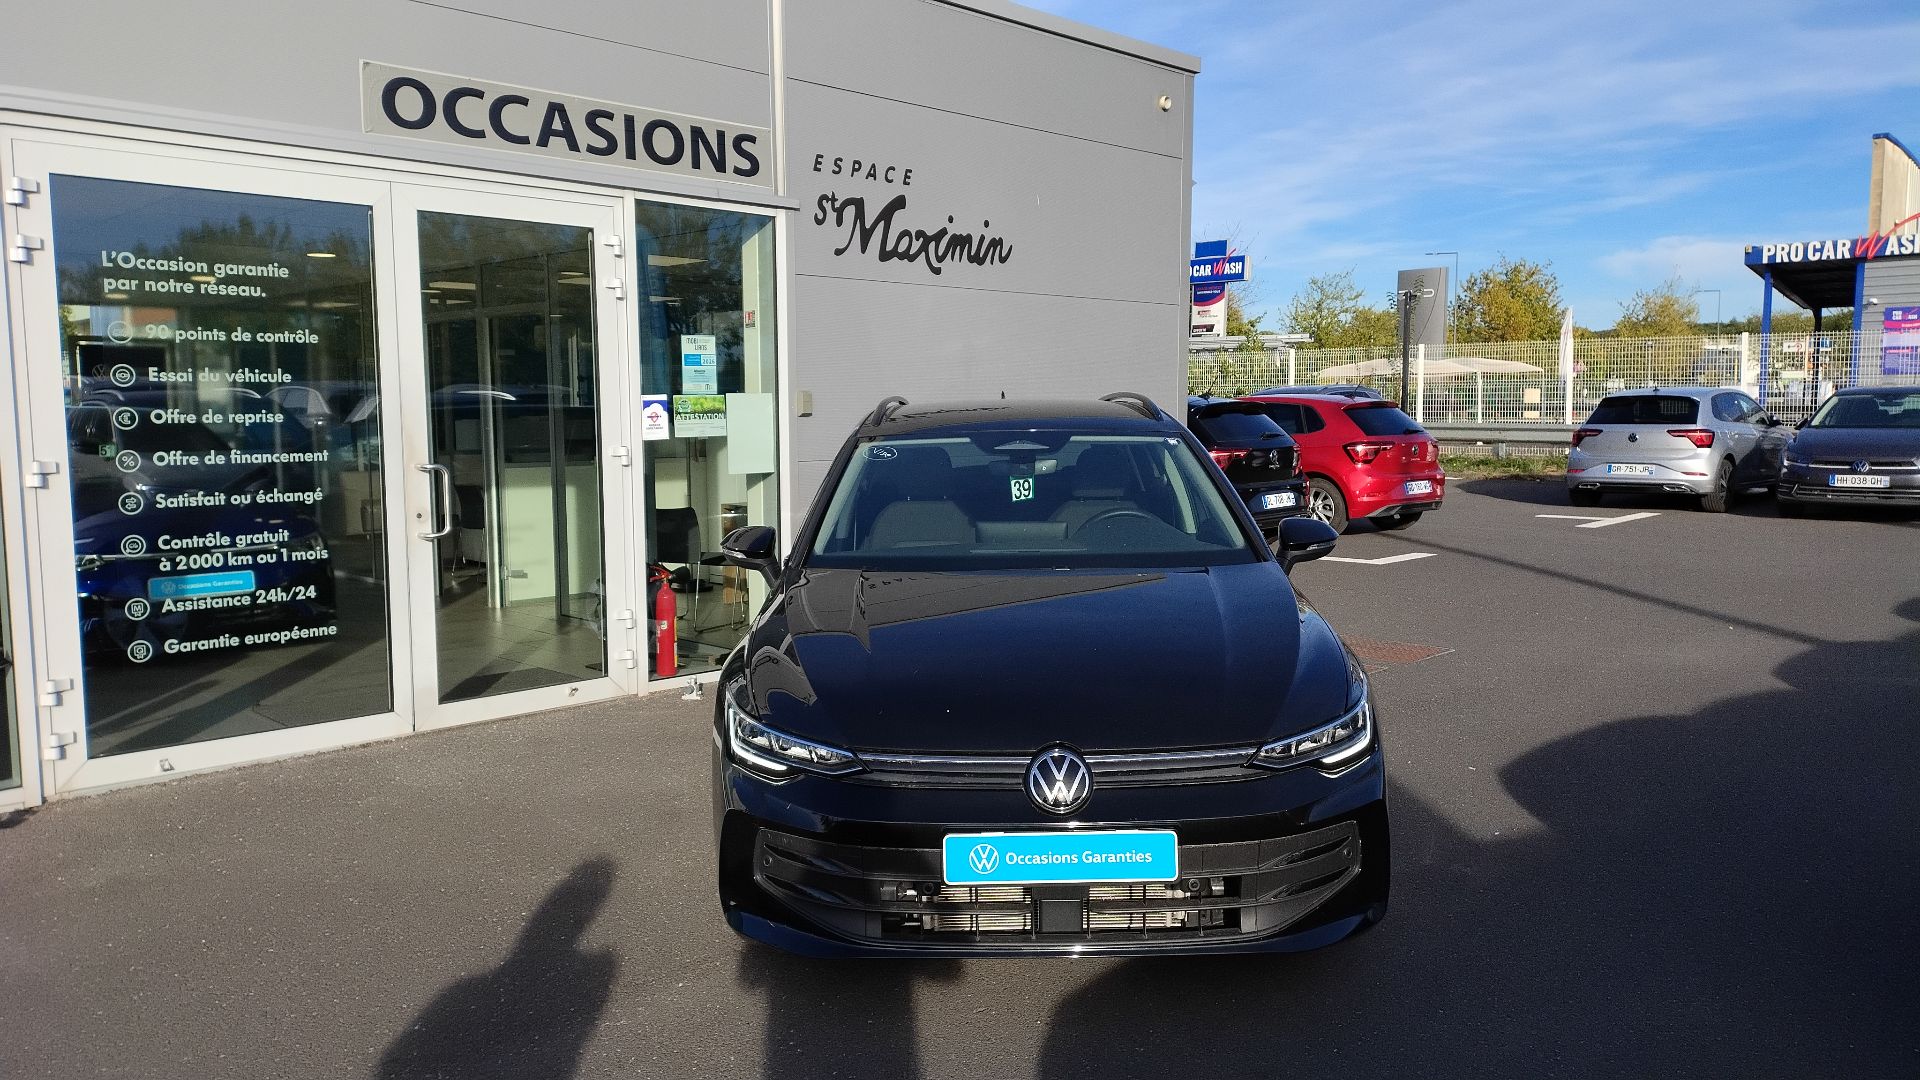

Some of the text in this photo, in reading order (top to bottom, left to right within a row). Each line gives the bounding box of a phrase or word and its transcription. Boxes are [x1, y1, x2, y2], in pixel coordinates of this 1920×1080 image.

[381, 76, 760, 178] OCCASIONS
[813, 154, 913, 186] ESPACE
[834, 194, 1013, 275] Maximin
[1762, 241, 1803, 264] PRO
[1807, 239, 1851, 261] CAR
[101, 250, 290, 279] L'Occasion garantie
[1193, 264, 1211, 277] CAR
[1214, 250, 1243, 276] WASH
[103, 278, 267, 297] par notre réseau.
[145, 324, 319, 344] 90 points de contrôle
[148, 367, 292, 383] Essai du véhicule
[150, 408, 284, 427] Offre de reprise
[675, 413, 726, 421] ATTESTATION
[152, 449, 329, 466] Offre de financement
[155, 487, 323, 508] Satisfait ou échangé
[1012, 478, 1032, 500] 39
[157, 529, 290, 549] Contrôle gratuit
[159, 557, 171, 572] à
[227, 552, 253, 567] km
[256, 551, 277, 564] ou
[280, 548, 288, 563] 1
[291, 547, 329, 562] mois
[161, 585, 317, 613] Assistance 24h/24
[164, 625, 337, 654] Garantie européenne
[1005, 851, 1078, 866] Occasions
[1082, 849, 1153, 865] Garanties
